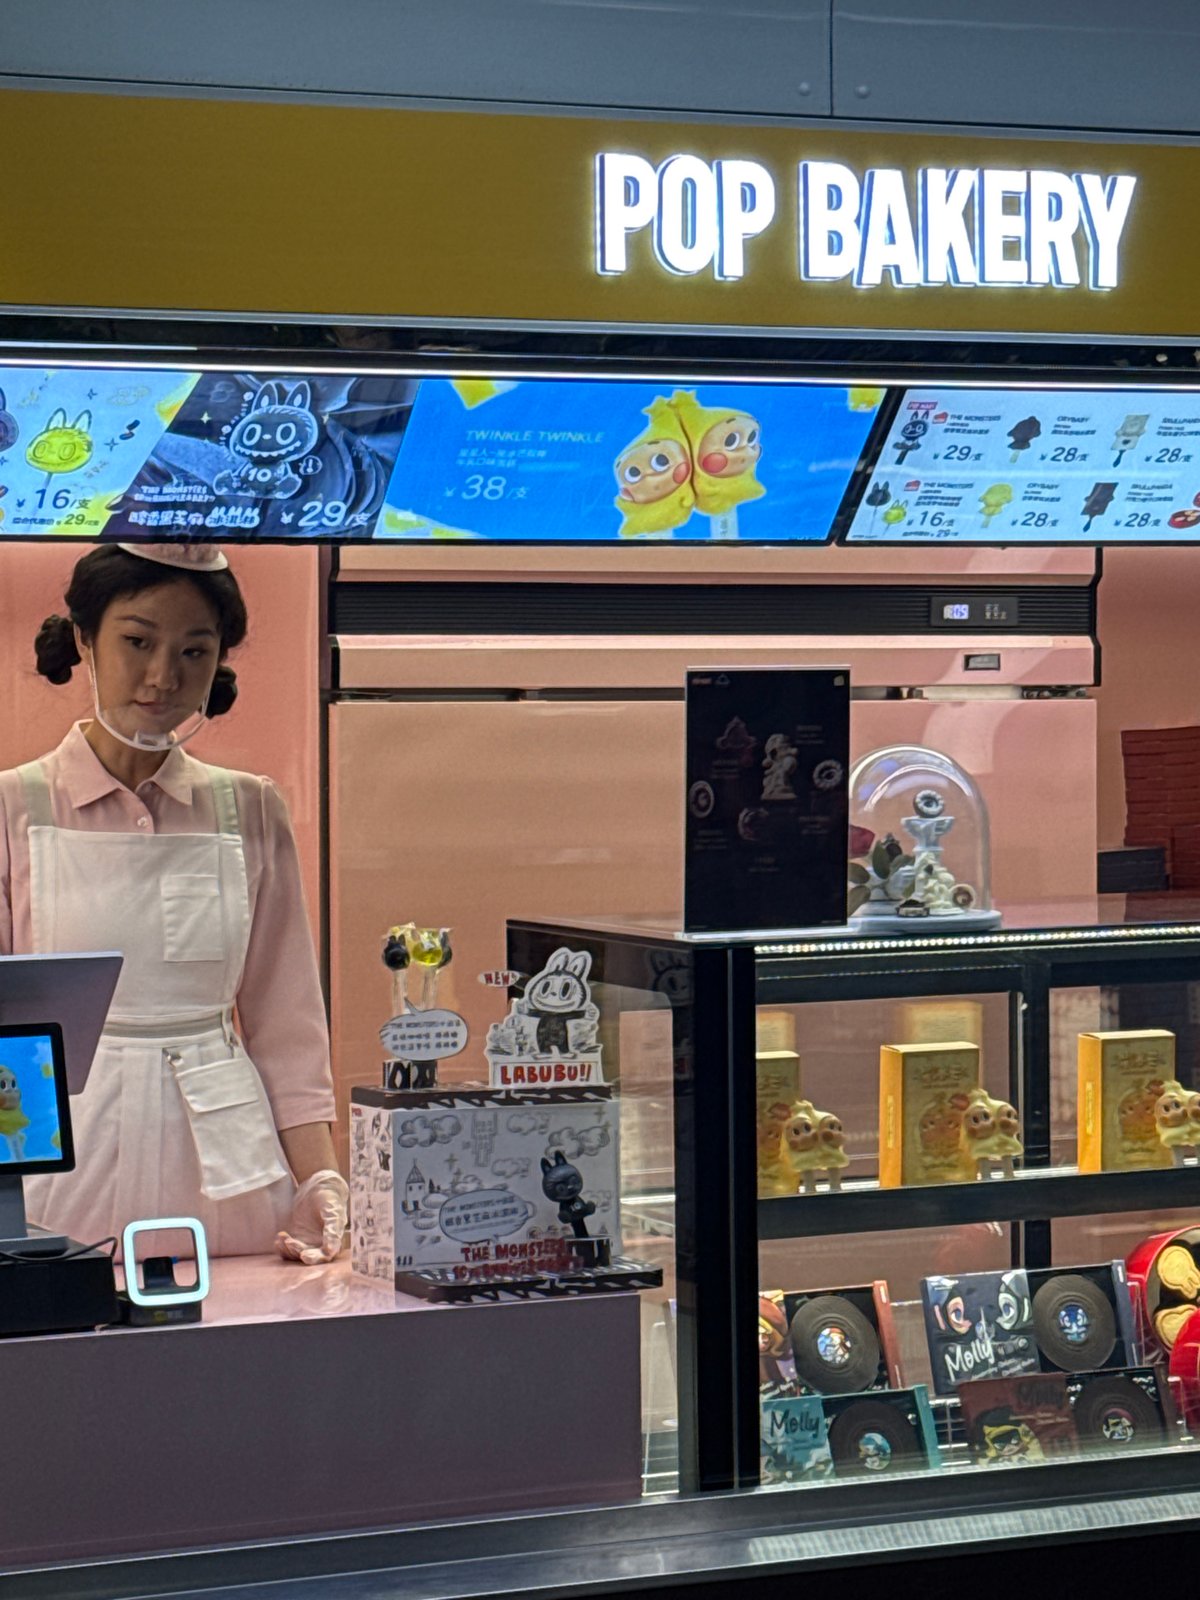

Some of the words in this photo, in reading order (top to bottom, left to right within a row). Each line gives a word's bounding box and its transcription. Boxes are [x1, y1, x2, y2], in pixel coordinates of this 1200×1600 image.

[596, 152, 775, 281] POP
[799, 161, 1138, 291] BAKERY
[465, 430, 533, 442] TWINKLE
[537, 431, 606, 444] TWINKLE
[461, 1246, 490, 1262] THE
[944, 1337, 995, 1382] Molly
[770, 1408, 820, 1439] Molly
